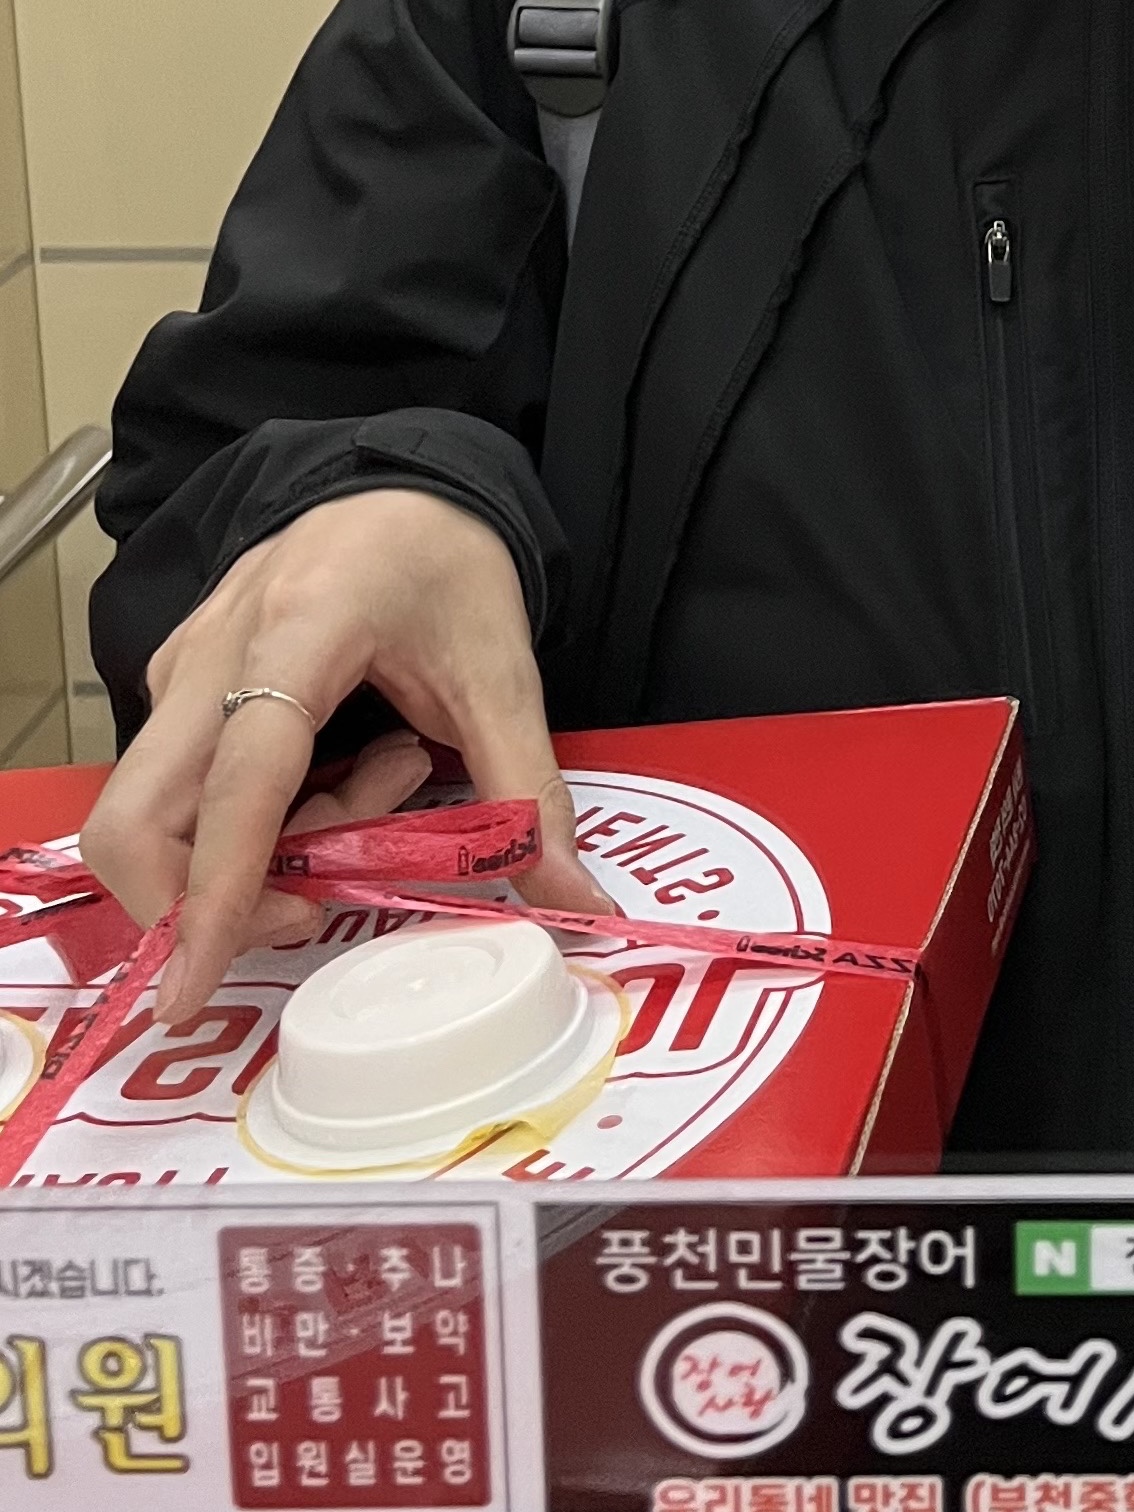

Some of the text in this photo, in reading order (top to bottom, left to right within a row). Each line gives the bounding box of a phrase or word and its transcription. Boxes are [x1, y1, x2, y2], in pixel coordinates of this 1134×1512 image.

[596, 1226, 976, 1293] 풍천민물장어
[1032, 1239, 1077, 1277] N
[246, 1375, 471, 1423] 교통사고
[249, 1439, 474, 1488] 입원실운영
